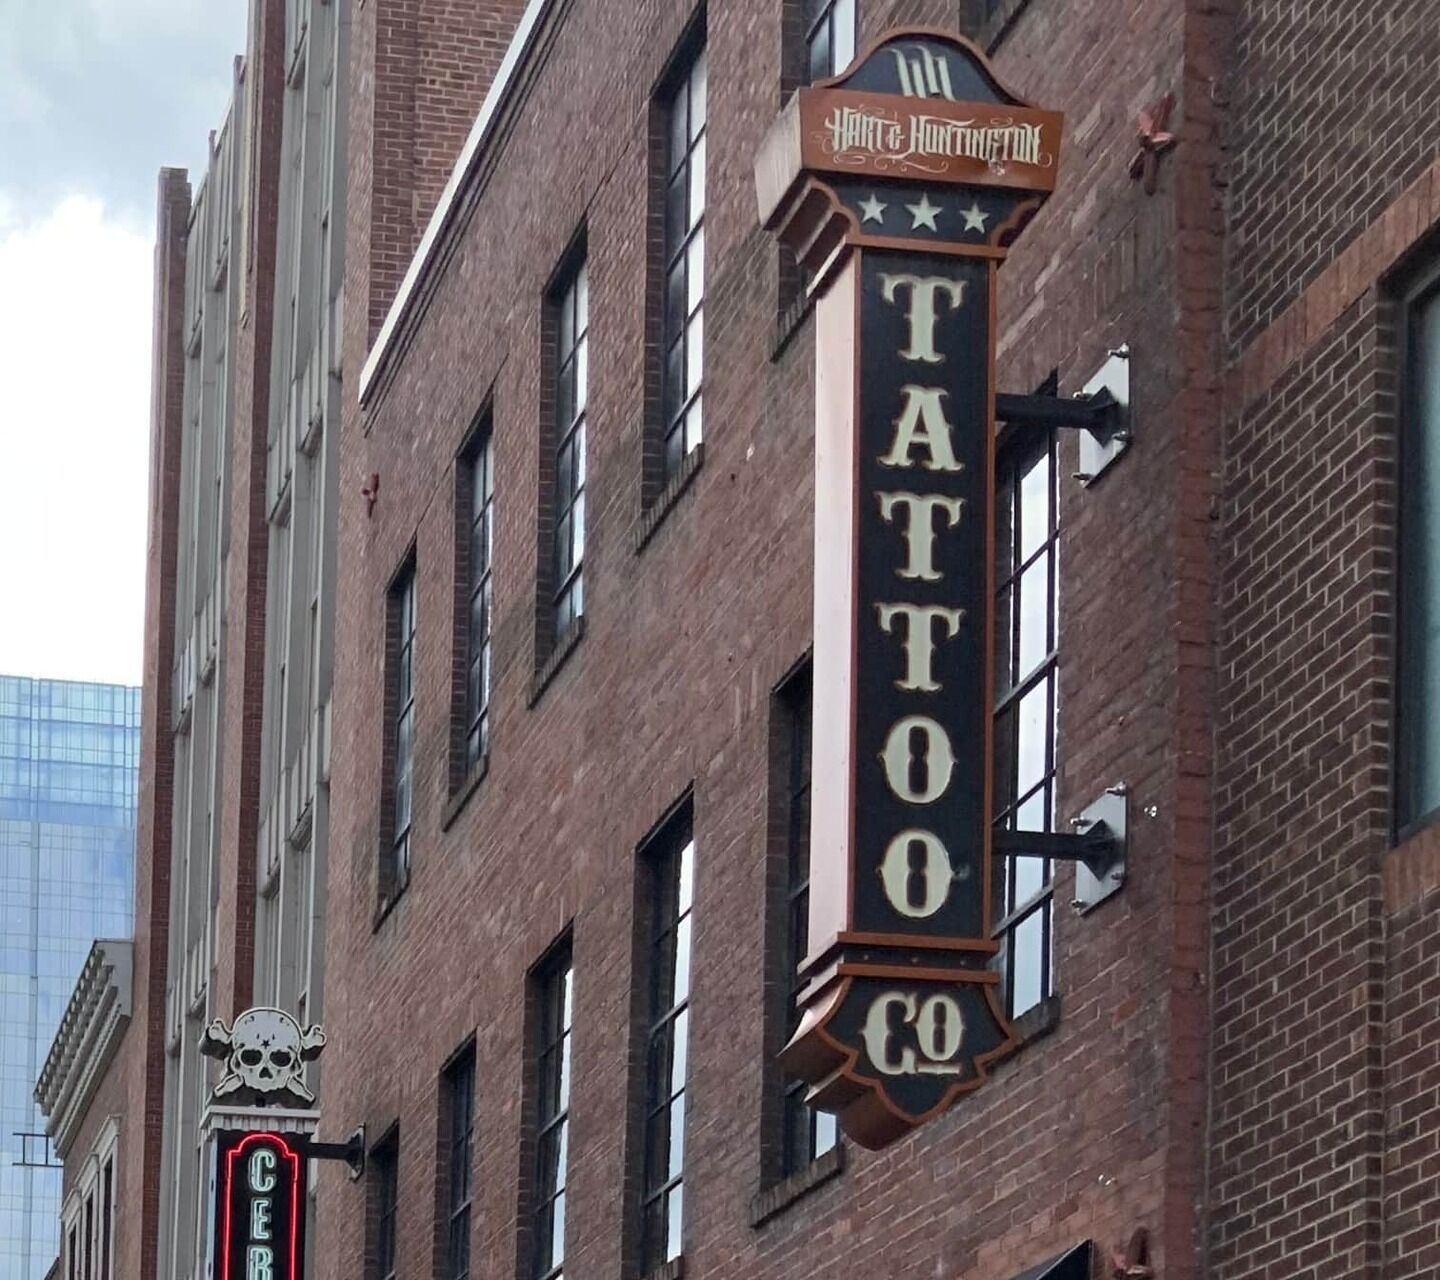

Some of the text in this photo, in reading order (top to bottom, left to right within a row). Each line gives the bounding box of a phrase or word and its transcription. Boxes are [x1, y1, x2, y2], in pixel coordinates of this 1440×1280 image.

[824, 107, 1045, 165] HART & HUNTINGTON
[874, 272, 966, 919] TATTOO
